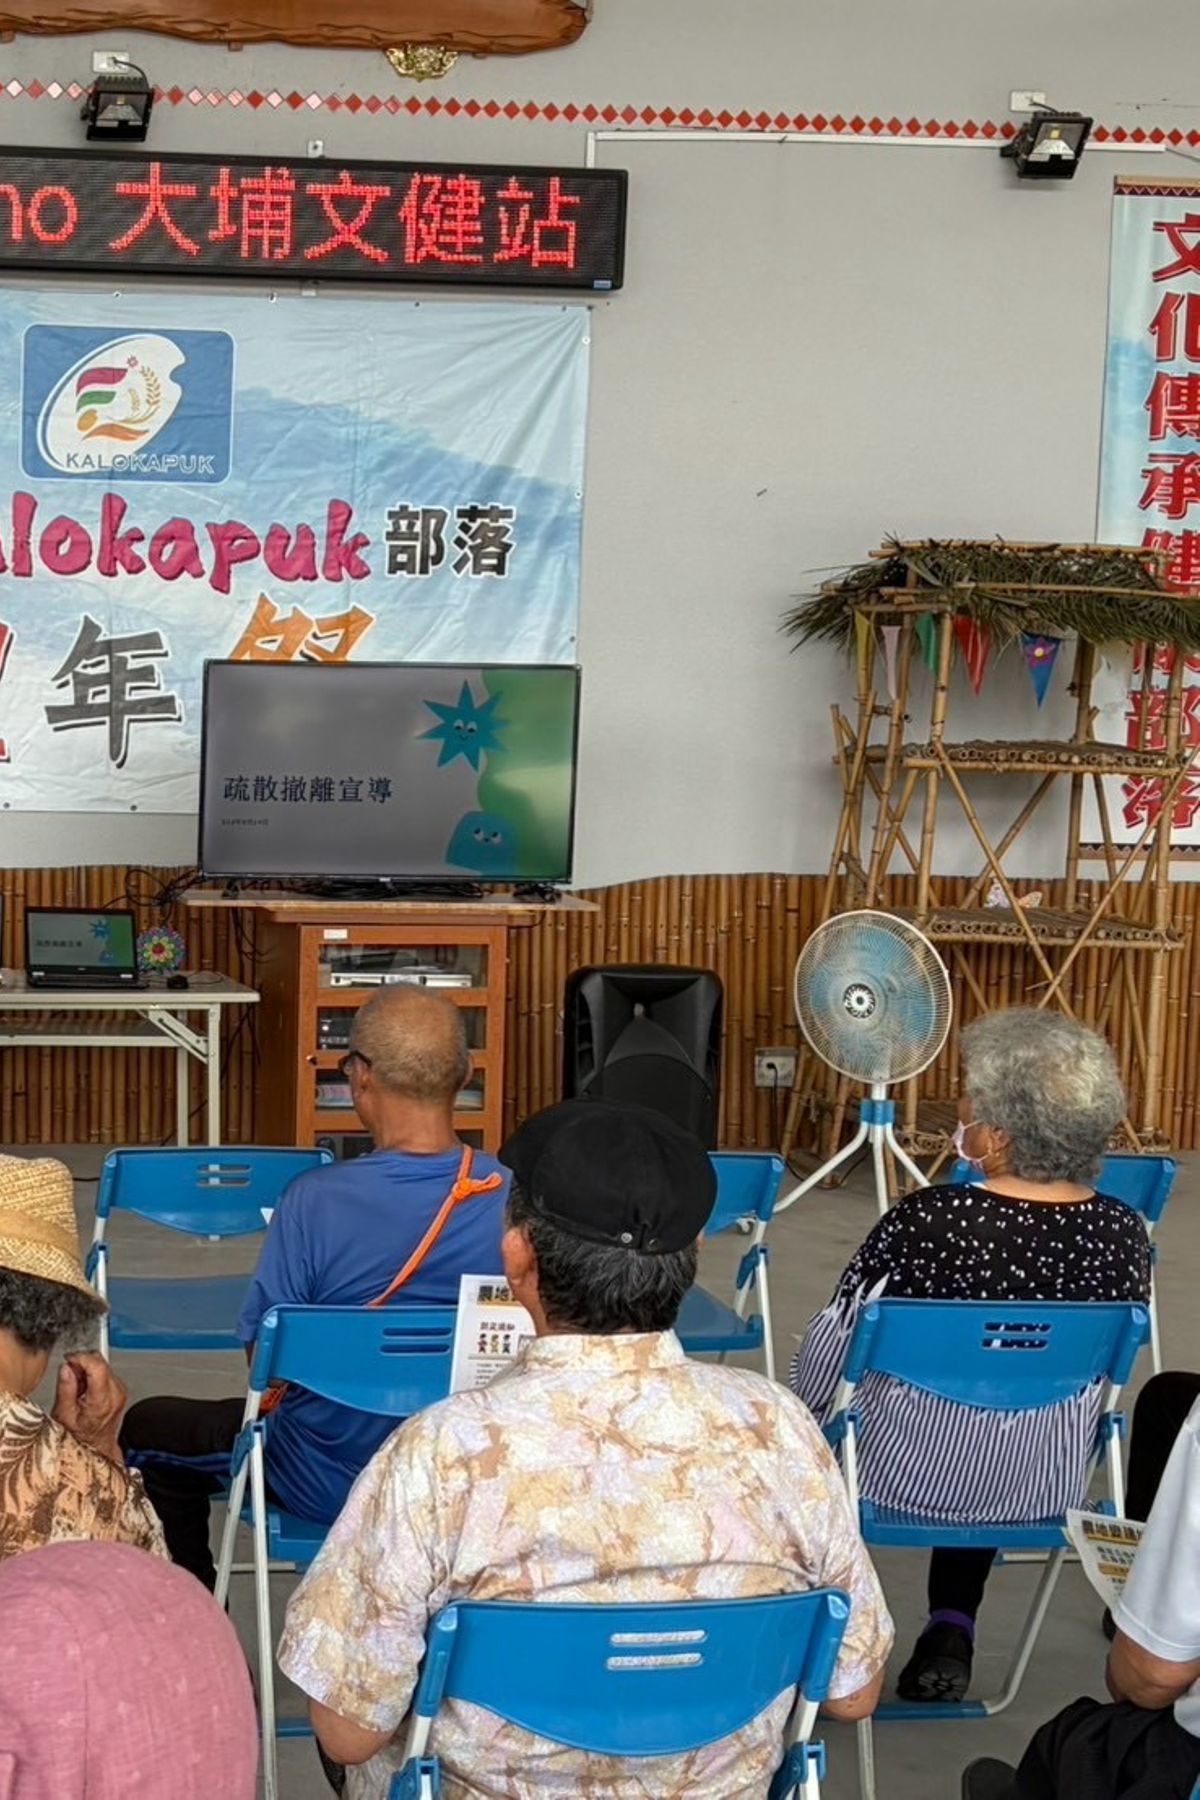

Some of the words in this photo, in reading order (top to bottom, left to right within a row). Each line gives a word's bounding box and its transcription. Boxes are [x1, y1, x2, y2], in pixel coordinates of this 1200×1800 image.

[109, 162, 577, 268] 大埔文健站
[65, 452, 215, 474] KALOKAPUK
[383, 504, 513, 579] 部落
[223, 774, 393, 804] 疏散撤離宣導
